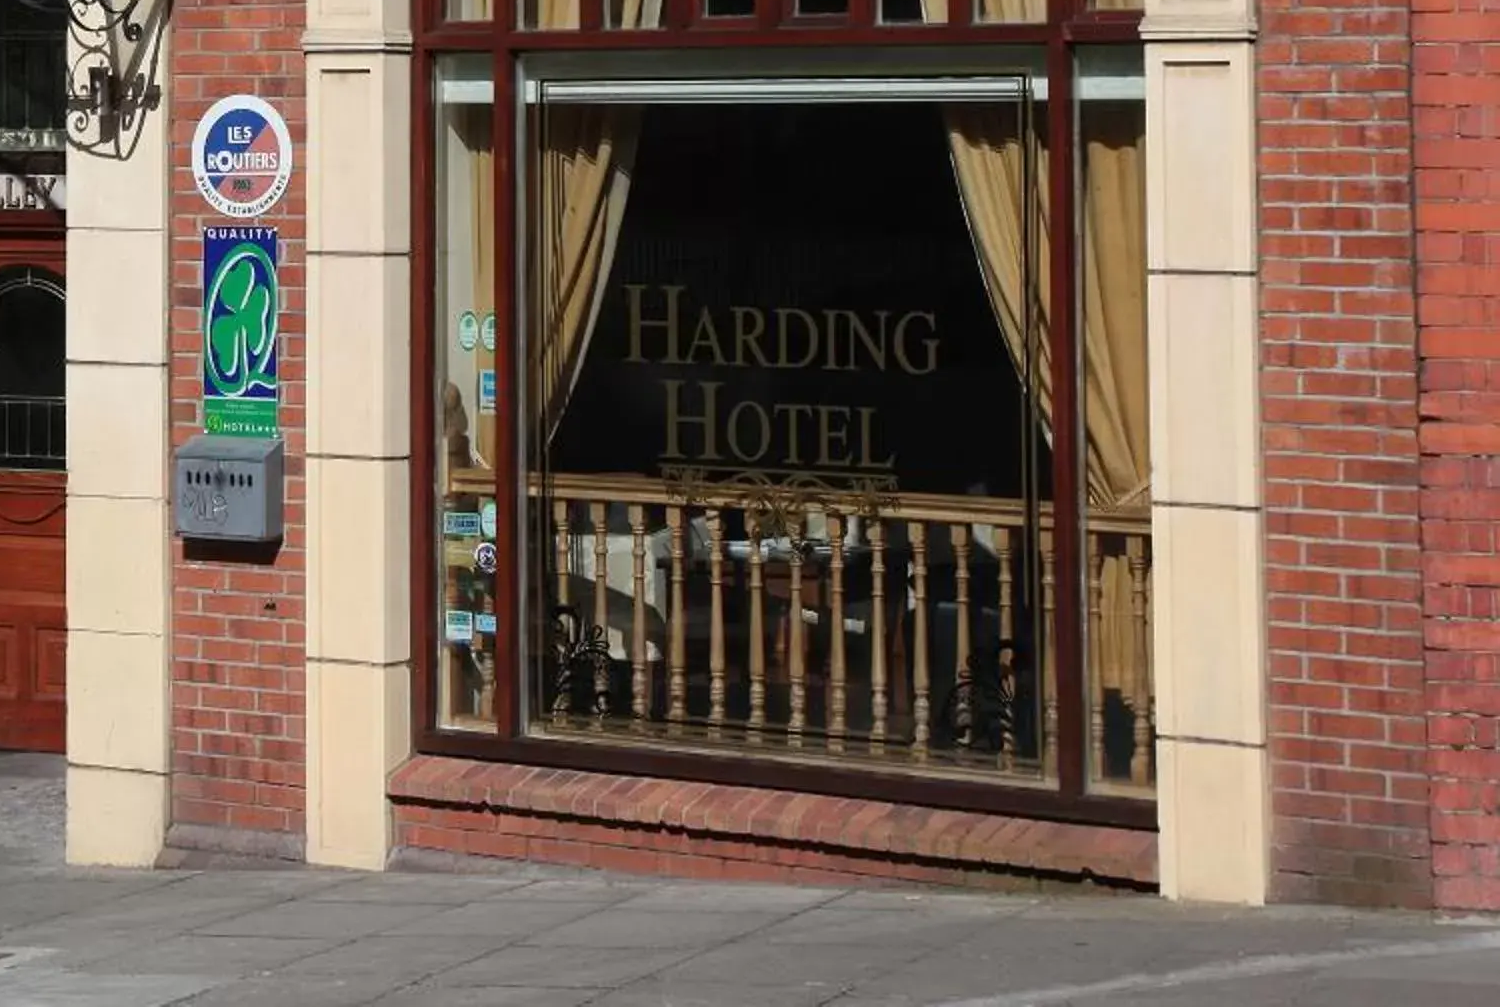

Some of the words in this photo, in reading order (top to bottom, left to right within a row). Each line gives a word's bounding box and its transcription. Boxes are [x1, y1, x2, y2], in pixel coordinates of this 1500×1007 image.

[227, 126, 252, 144] LES
[207, 150, 277, 172] ROUTIERS
[207, 228, 273, 240] QUALITY
[622, 283, 940, 376] HARDING
[659, 379, 897, 469] HOTEL
